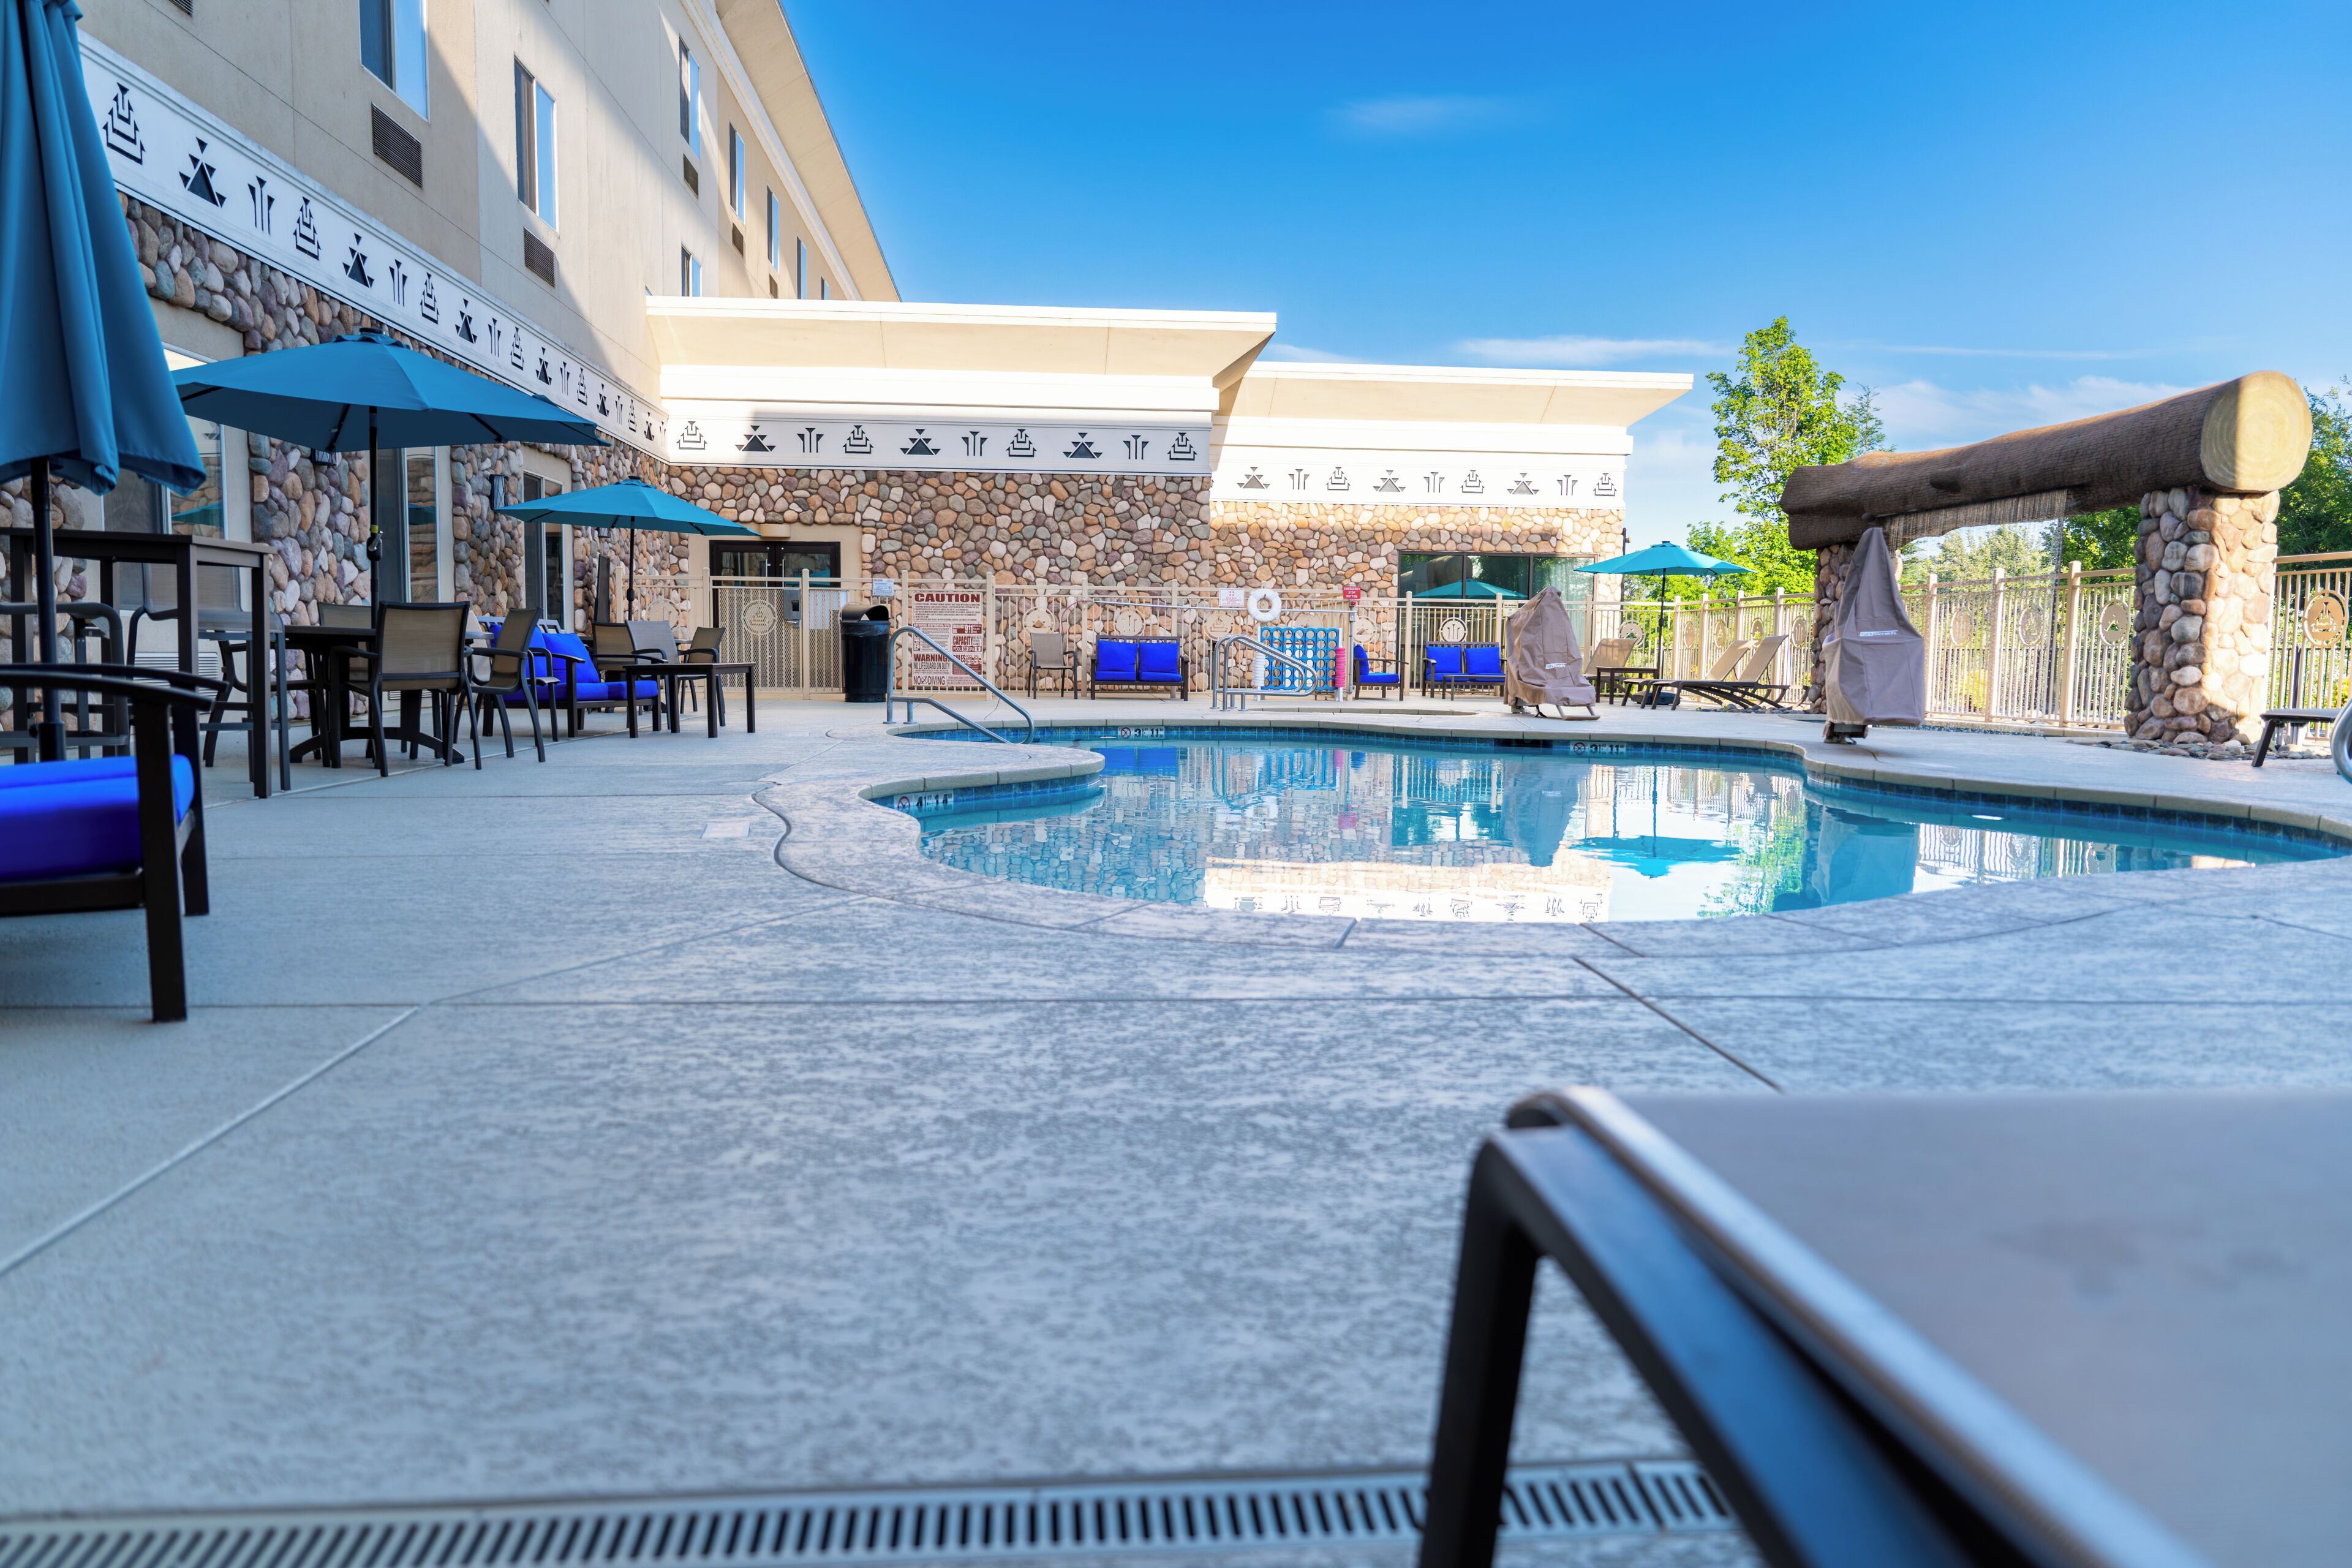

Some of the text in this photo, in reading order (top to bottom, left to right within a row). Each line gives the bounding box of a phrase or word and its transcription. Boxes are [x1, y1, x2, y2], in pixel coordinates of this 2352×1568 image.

[914, 593, 980, 603] CAUTION
[953, 636, 973, 645] CAPACITY
[913, 676, 945, 685] NO DIVING
